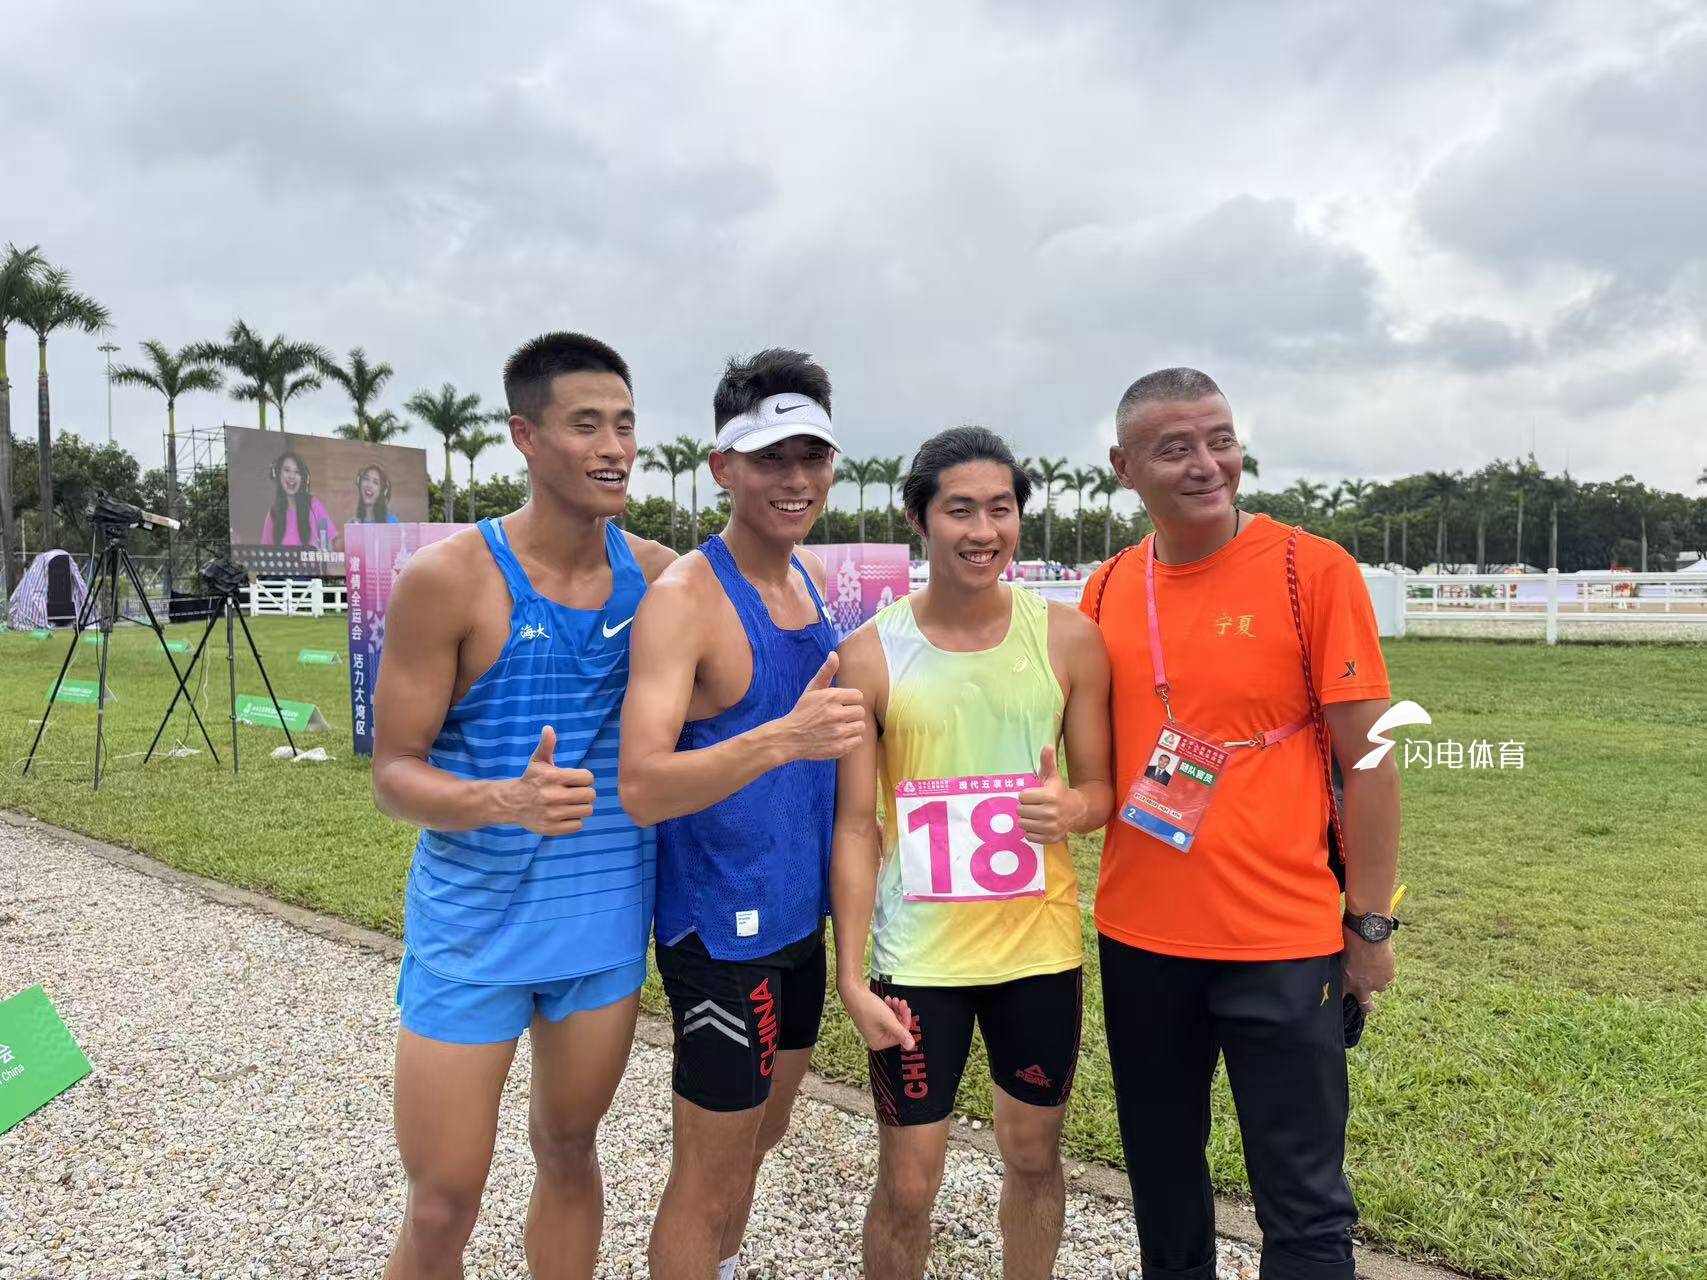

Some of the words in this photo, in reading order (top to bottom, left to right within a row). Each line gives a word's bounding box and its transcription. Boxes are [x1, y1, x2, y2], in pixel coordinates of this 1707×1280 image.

[520, 622, 550, 640] 海大
[1215, 612, 1256, 639] 宁夏
[353, 653, 366, 736] 活力大湾区
[1127, 807, 1137, 819] 2
[907, 796, 1038, 894] 18
[750, 977, 778, 1076] CHINA
[1, 1064, 25, 1081] China
